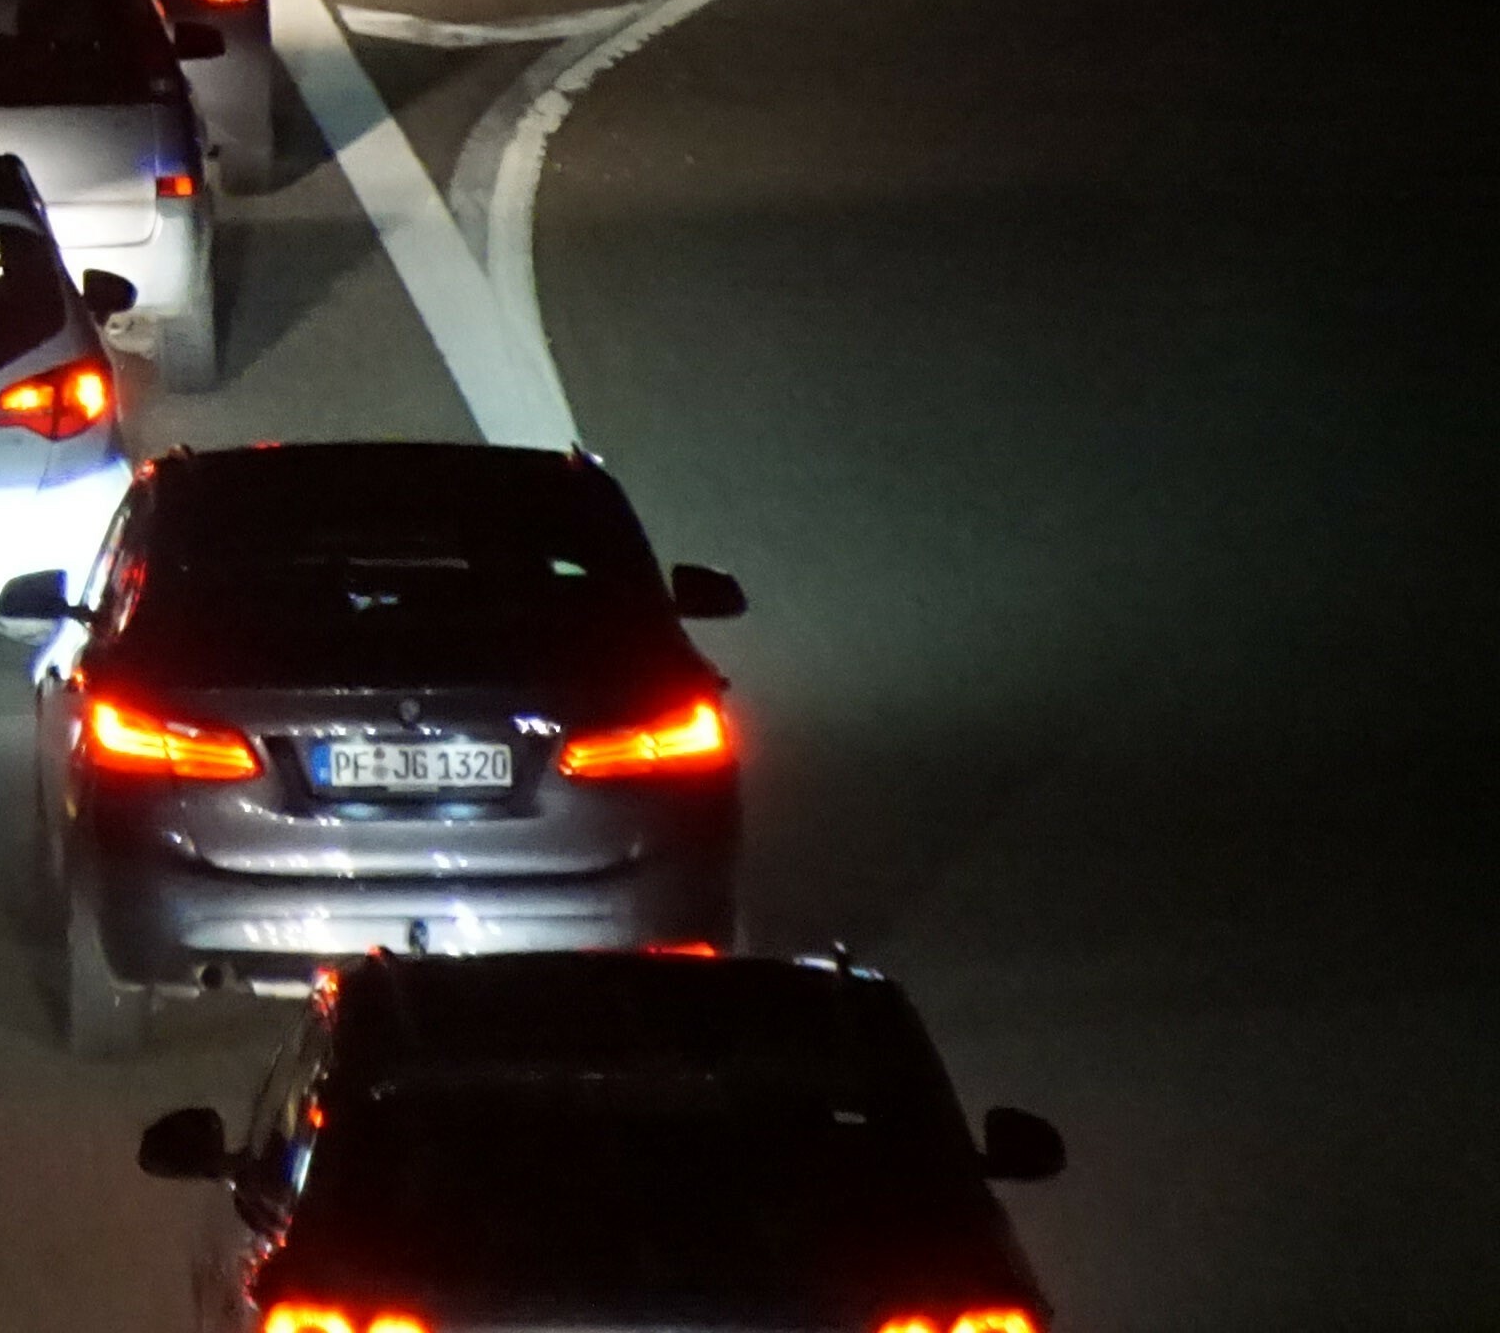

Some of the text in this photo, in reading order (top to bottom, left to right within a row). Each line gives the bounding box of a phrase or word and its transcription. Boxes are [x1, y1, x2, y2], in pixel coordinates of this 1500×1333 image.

[335, 750, 509, 781] PF JG 1320
